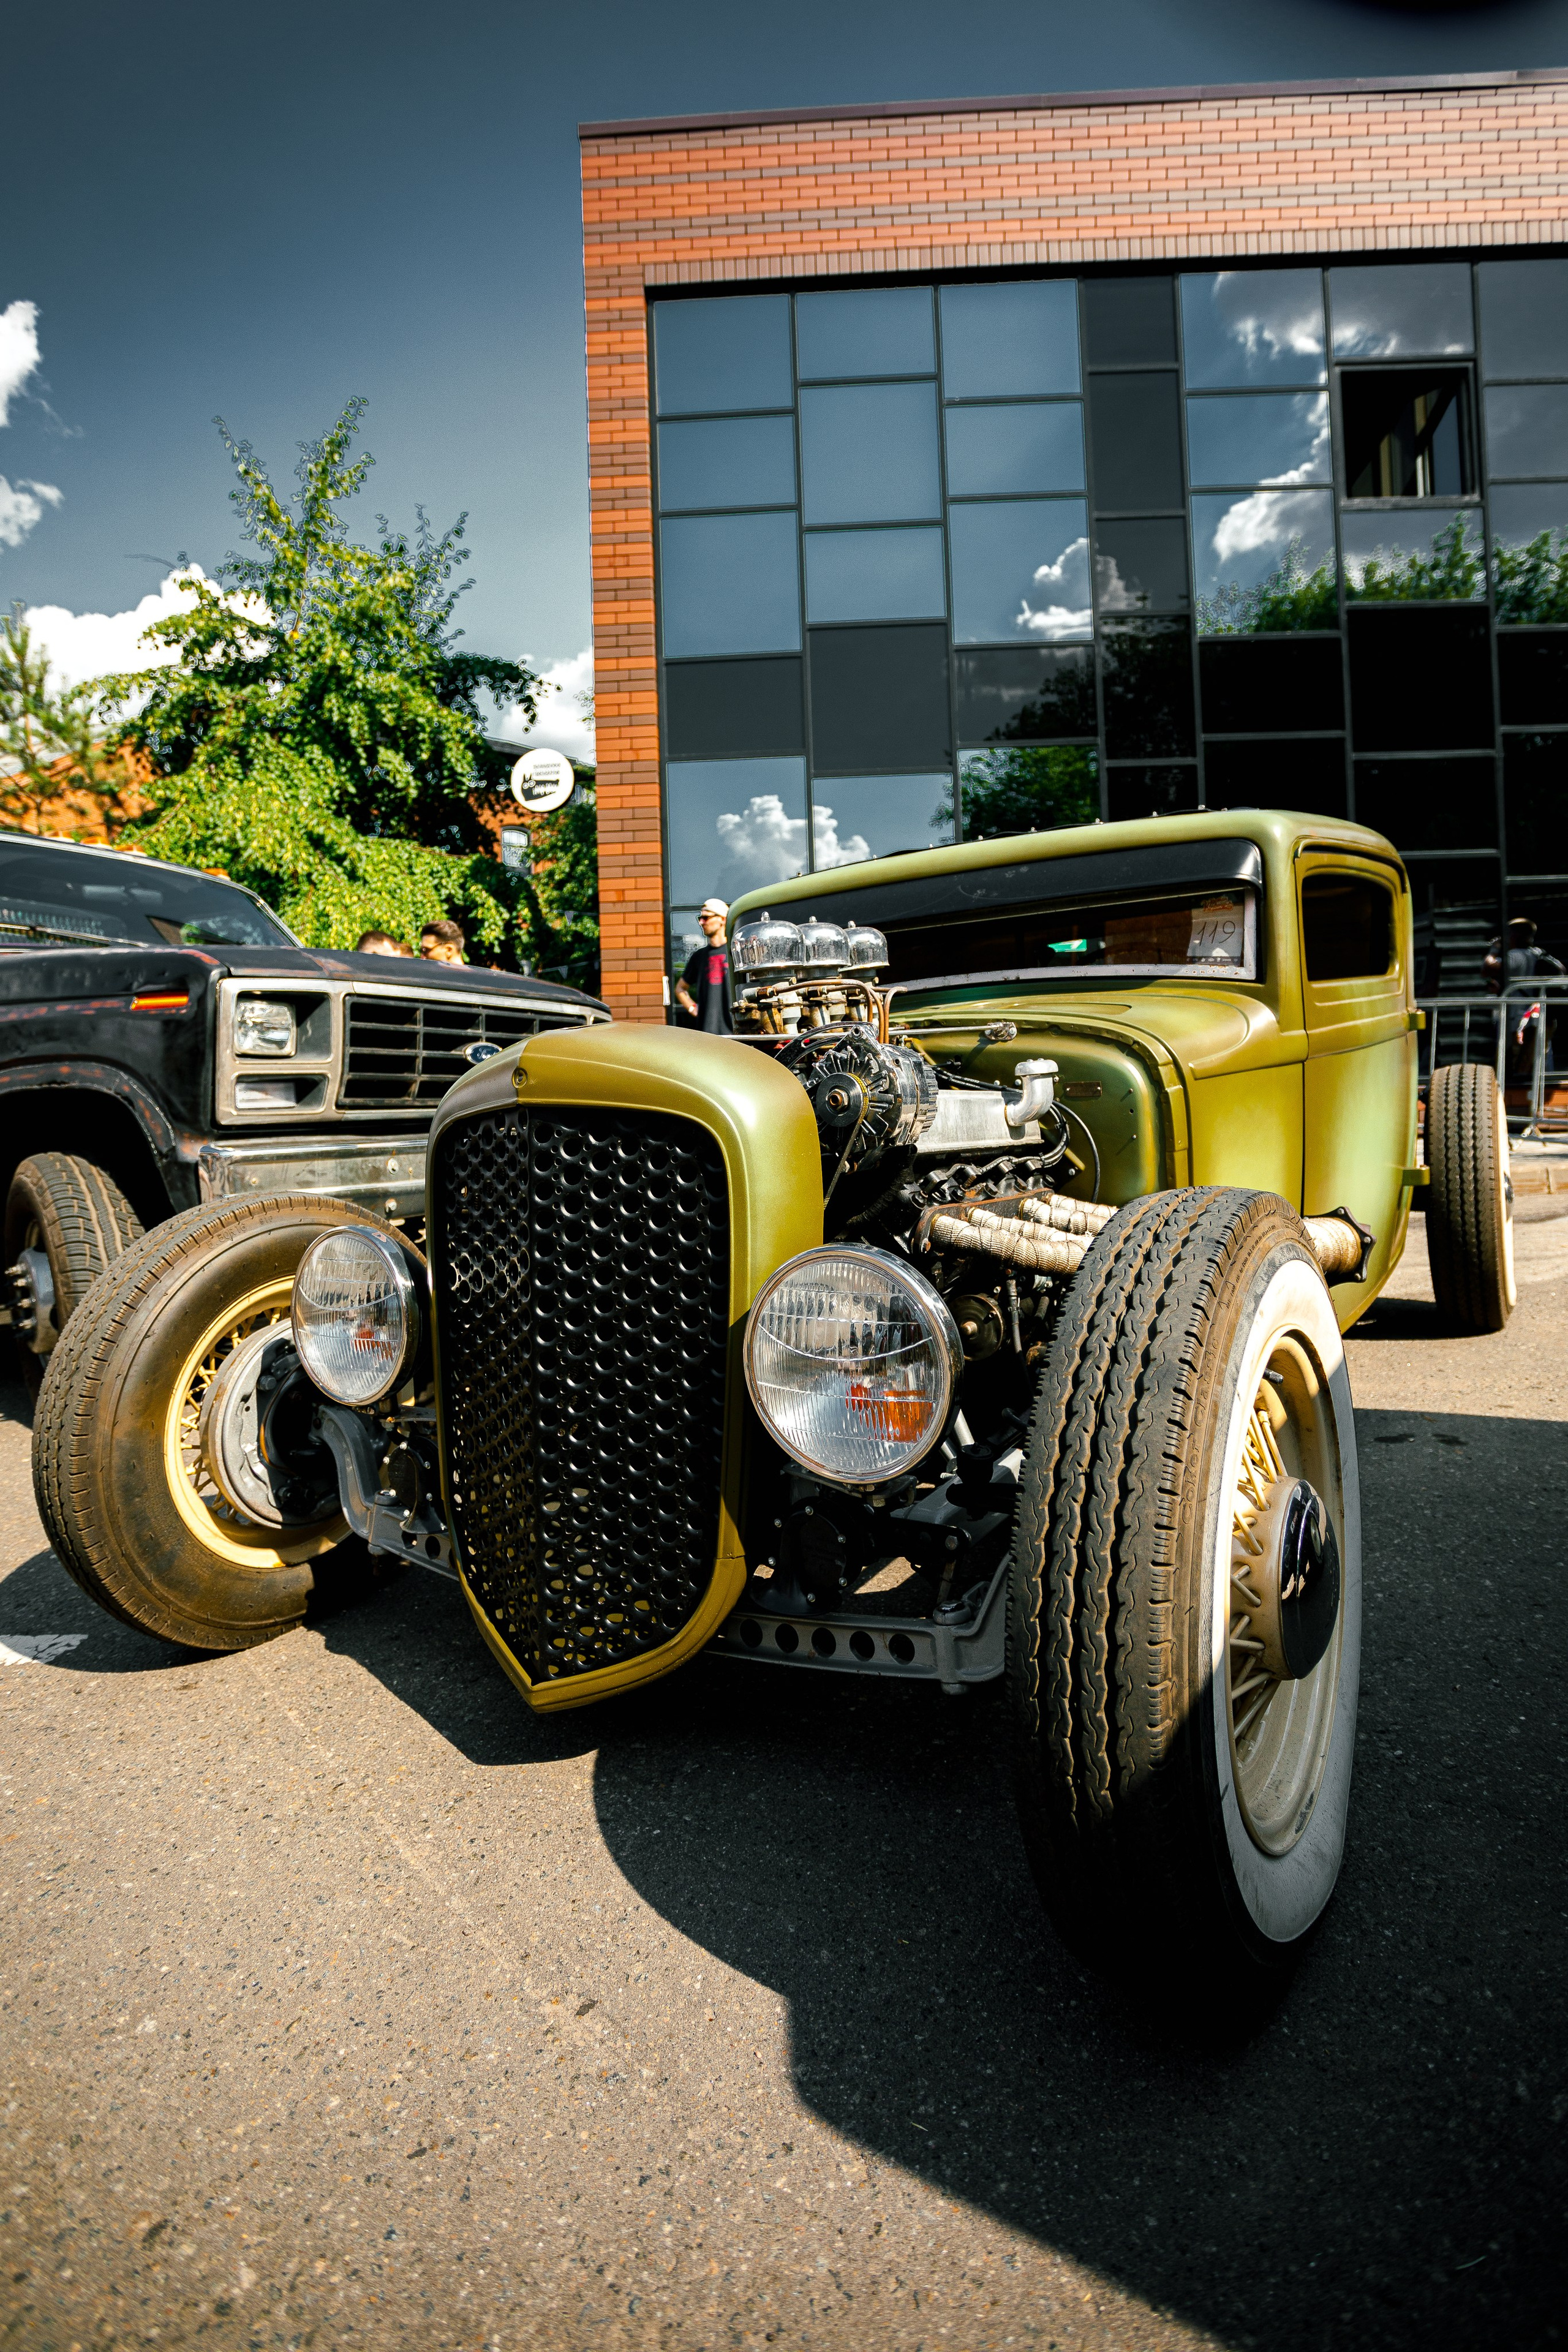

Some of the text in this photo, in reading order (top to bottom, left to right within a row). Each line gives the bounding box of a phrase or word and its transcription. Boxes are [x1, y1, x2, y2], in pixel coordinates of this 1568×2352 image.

[1197, 921, 1236, 946] 119
[1182, 1337, 1219, 1524] Coker Classic
